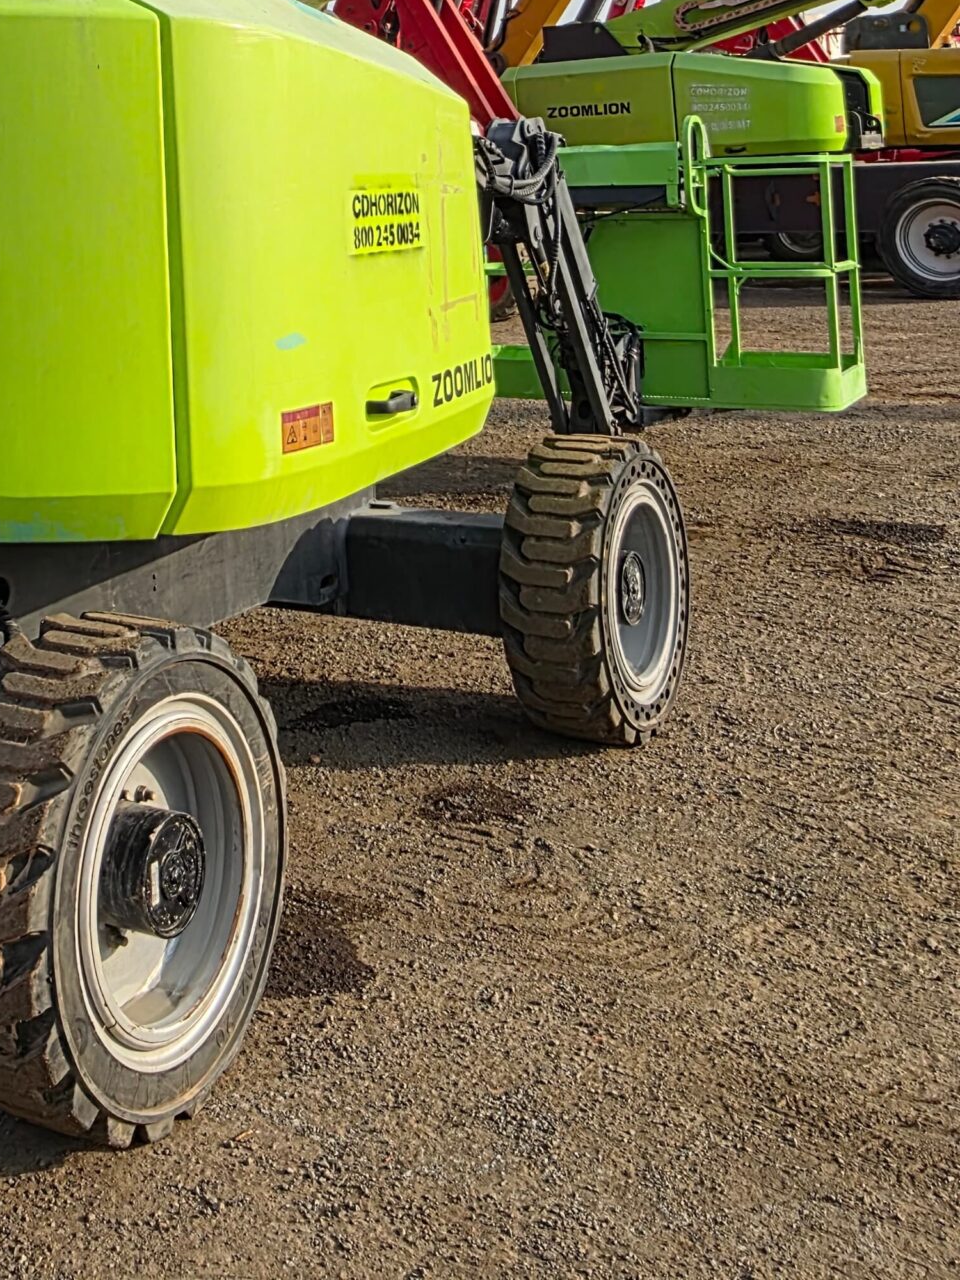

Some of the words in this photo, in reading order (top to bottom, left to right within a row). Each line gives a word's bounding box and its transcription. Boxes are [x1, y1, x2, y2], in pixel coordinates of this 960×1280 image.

[546, 101, 632, 119] ZOOMLION
[352, 191, 420, 220] CDHORIZON
[353, 225, 374, 250] 800
[375, 224, 396, 247] 245
[396, 221, 421, 246] 0034
